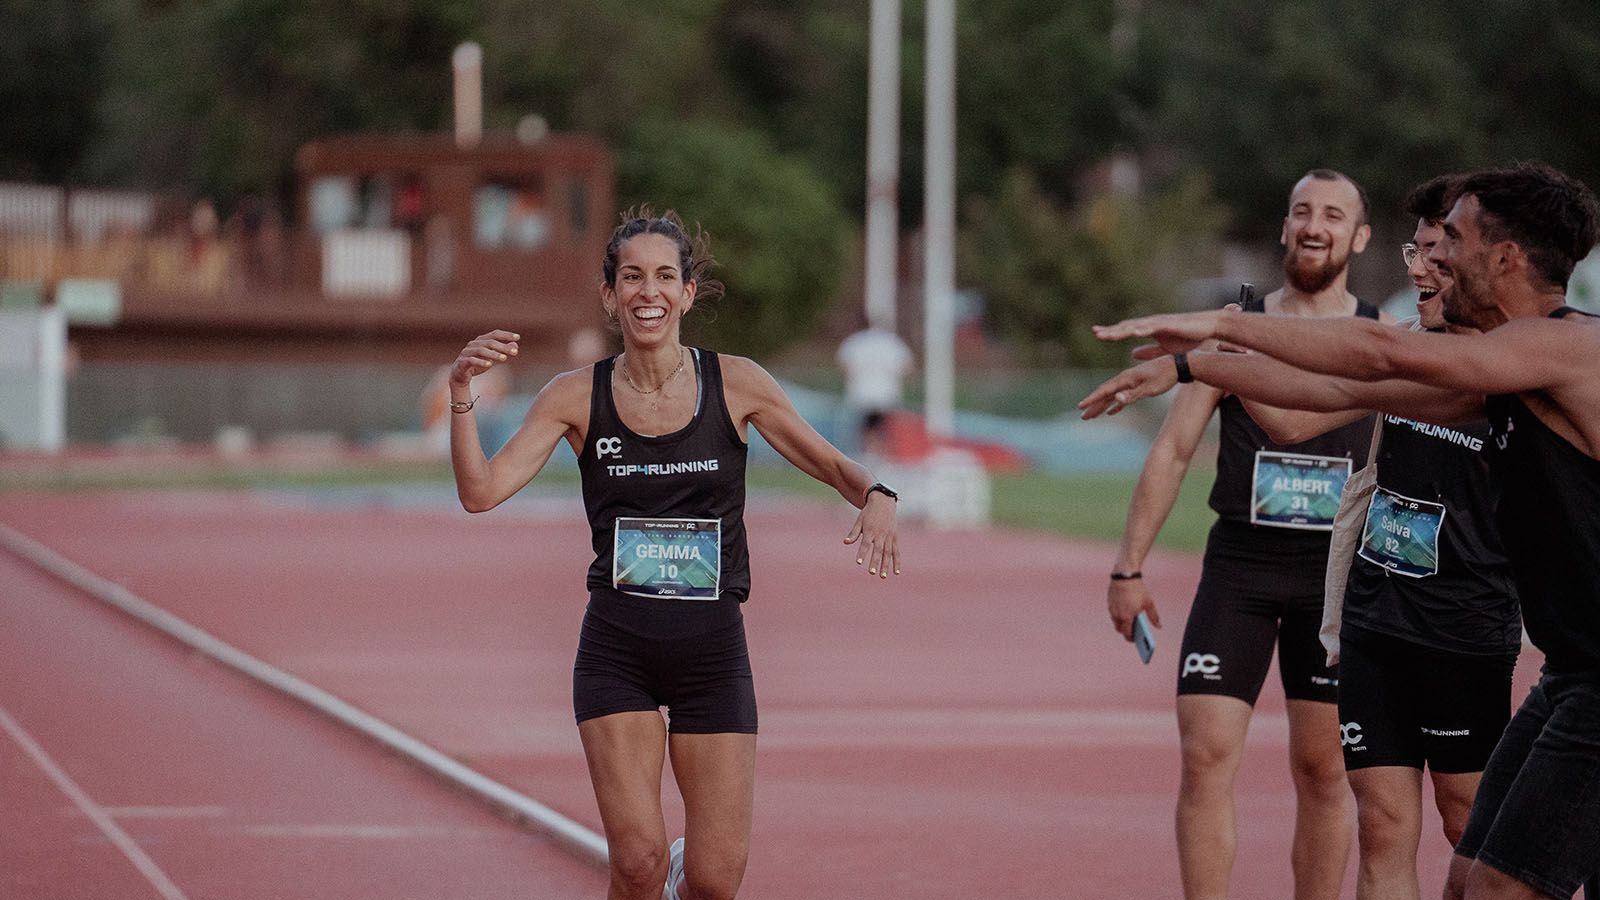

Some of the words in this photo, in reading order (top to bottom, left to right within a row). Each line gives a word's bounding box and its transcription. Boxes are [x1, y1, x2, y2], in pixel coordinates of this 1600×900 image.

[607, 459, 719, 476] TOP4RUNNING
[1272, 477, 1333, 494] ALBERT
[1291, 496, 1309, 510] 31
[1381, 515, 1411, 538] Salva
[636, 544, 701, 560] GEMMA
[1385, 537, 1400, 553] 82
[658, 564, 678, 579] 10
